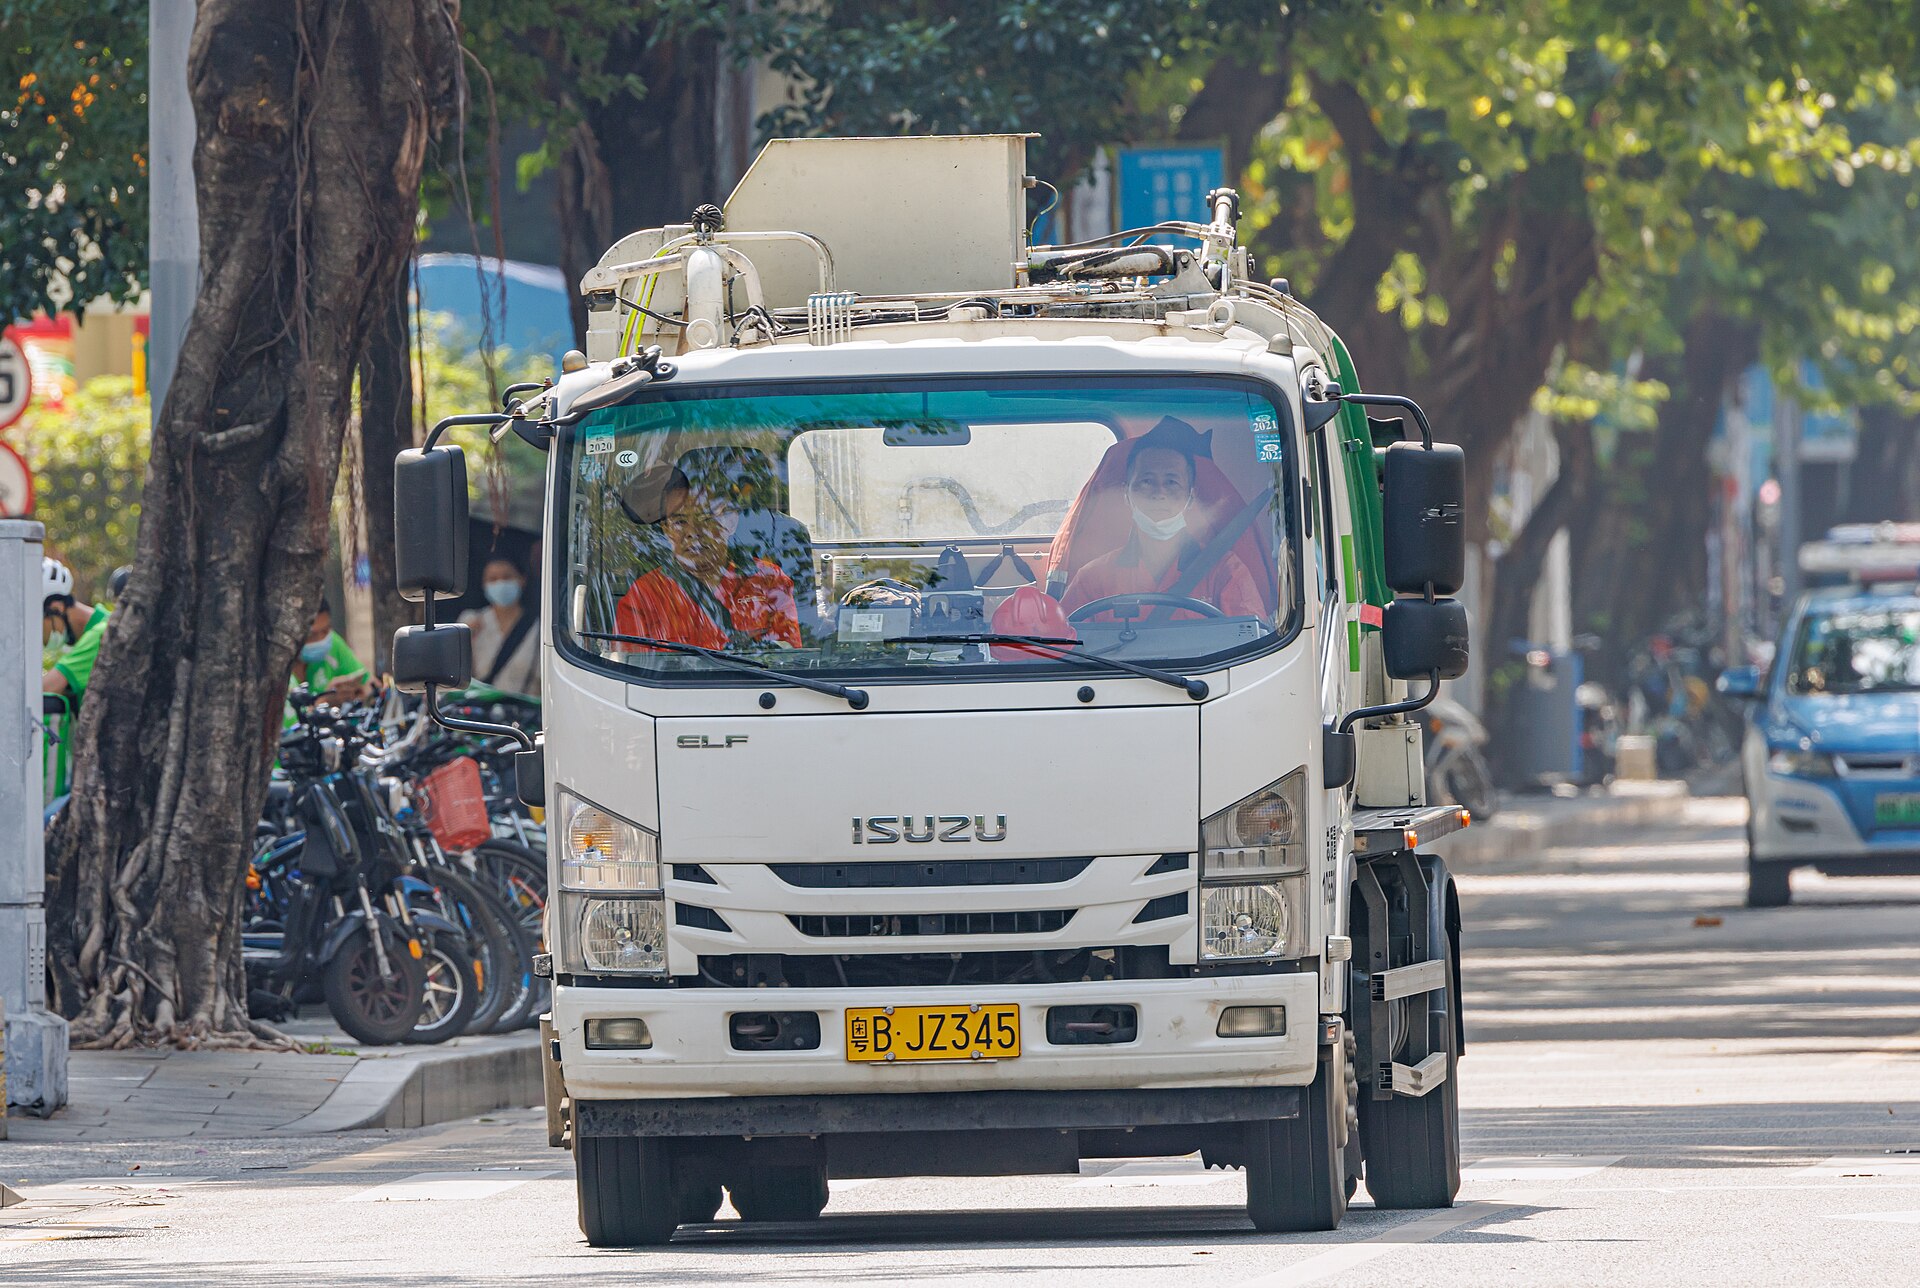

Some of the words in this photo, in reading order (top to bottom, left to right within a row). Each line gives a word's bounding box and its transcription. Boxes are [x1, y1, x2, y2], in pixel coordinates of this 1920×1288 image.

[1253, 420, 1277, 432] 2021
[589, 442, 612, 453] 2020
[677, 735, 749, 749] ELF
[852, 813, 1008, 844] ISUZU
